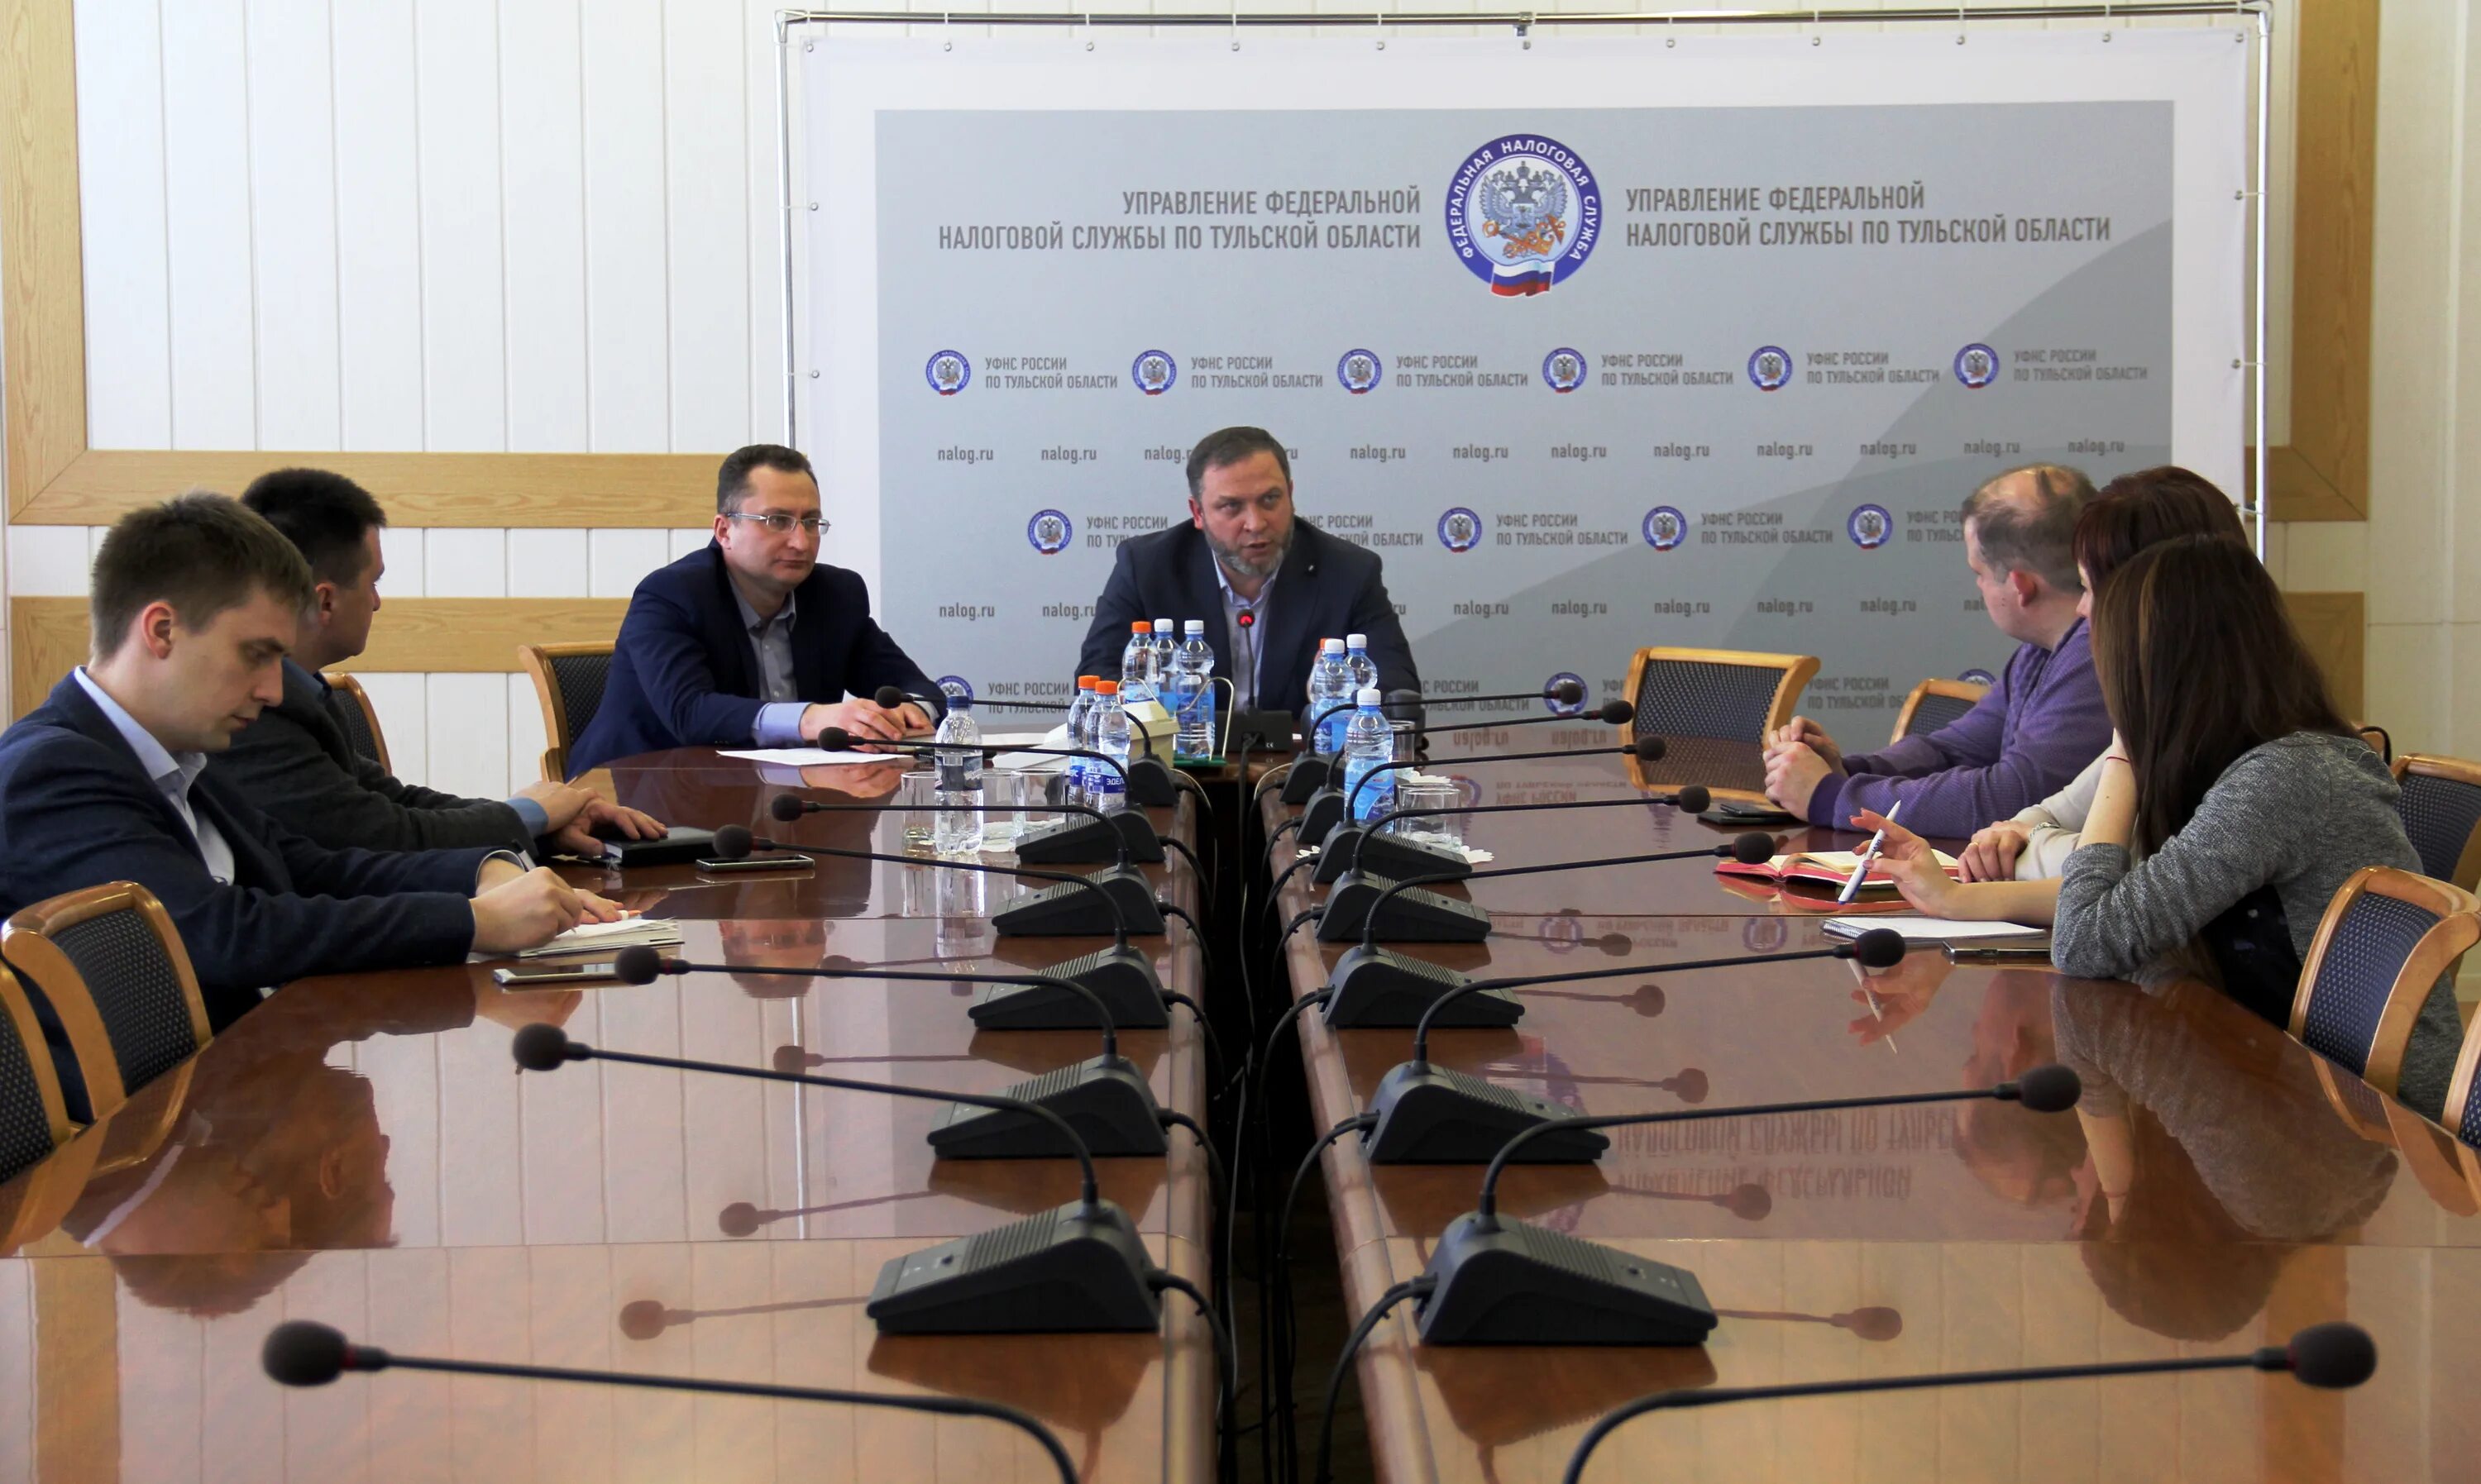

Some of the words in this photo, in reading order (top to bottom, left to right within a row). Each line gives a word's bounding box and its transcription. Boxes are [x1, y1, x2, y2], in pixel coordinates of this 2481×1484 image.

[1123, 191, 1257, 216] УПРАВЛЕНИЕ
[1266, 185, 1421, 217] ФЕДЕРАЛЬНОЙ
[1450, 150, 1494, 258] ФЕДЕРАЛЬНАЯ
[1501, 140, 1589, 186] НАЛОГОВАЯ
[1569, 195, 1597, 260] СЛУЖБА
[1627, 187, 1761, 212] УПРАВЛЕНИЕ
[1769, 180, 1924, 213] ФЕДЕРАЛЬНОЙ
[939, 220, 1064, 250] НАЛОГОВОЙ
[1073, 225, 1165, 250] СЛУЖБЫ
[1175, 225, 1202, 250] ПО
[1210, 220, 1318, 249] ТУЛЬСКОЙ
[1327, 224, 1420, 249] ОБЛАСТИ
[1627, 217, 1751, 247] НАЛОГОВОЙ
[1761, 222, 1853, 246] СЛУЖБЫ
[1863, 220, 1889, 246] ПО
[1898, 213, 2007, 245] ТУЛЬСКОЙ
[2015, 217, 2111, 243] ОБЛАСТИ
[985, 356, 1017, 371] УФНС
[1021, 356, 1067, 371] РОССИИ
[1191, 356, 1223, 370] УФНС
[1227, 356, 1273, 370] РОССИИ
[1396, 355, 1428, 369] УФНС
[1432, 355, 1478, 369] РОССИИ
[1601, 354, 1633, 367] УФНС
[1637, 354, 1683, 367] РОССИИ
[1806, 352, 1838, 365] УФНС
[1843, 352, 1889, 365] РОССИИ
[2015, 350, 2046, 363] УФНС
[2050, 350, 2096, 363] РОССИИ
[986, 373, 1001, 389] ПО
[1004, 371, 1063, 389] ТУЛЬСКОЙ
[1067, 373, 1117, 389] ОБЛАСТИ
[1192, 373, 1207, 389] ПО
[1211, 371, 1269, 389] ТУЛЬСКОЙ
[1273, 373, 1323, 389] ОБЛАСТИ
[1397, 371, 1412, 388] ПО
[1415, 370, 1474, 388] ТУЛЬСКОЙ
[1477, 371, 1528, 388] ОБЛАСТИ
[1602, 370, 1617, 386] ПО
[1621, 369, 1679, 386] ТУЛЬСКОЙ
[1683, 370, 1734, 386] ОБЛАСТИ
[1807, 369, 1823, 384] ПО
[1826, 367, 1885, 384] ТУЛЬСКОЙ
[1888, 369, 1939, 384] ОБЛАСТИ
[2014, 368, 2029, 382] ПО
[2033, 366, 2092, 382] ТУЛЬСКОЙ
[2096, 368, 2148, 382] ОБЛАСТИ
[939, 446, 993, 465] nalog.ru
[1042, 446, 1097, 465] nalog.ru
[1350, 444, 1406, 463] nalog.ru
[1453, 444, 1509, 463] nalog.ru
[1551, 443, 1607, 462] nalog.ru
[1654, 442, 1709, 460] nalog.ru
[1757, 441, 1813, 460] nalog.ru
[1862, 441, 1916, 459] nalog.ru
[1964, 440, 2020, 458] nalog.ru
[2068, 438, 2124, 456] nalog.ru
[1087, 516, 1118, 529] УФНС
[1122, 516, 1168, 529] РОССИИ
[1327, 515, 1374, 527] РОССИИ
[1496, 514, 1528, 527] УФНС
[1532, 514, 1578, 527] РОССИИ
[1701, 513, 1733, 525] УФНС
[1738, 513, 1783, 525] РОССИИ
[1087, 535, 1102, 547] ПО
[1373, 533, 1423, 546] ОБЛАСТИ
[1497, 531, 1512, 546] ПО
[1516, 529, 1573, 546] ТУЛЬСКОЙ
[1577, 531, 1628, 546] ОБЛАСТИ
[1702, 529, 1717, 544] ПО
[1721, 527, 1778, 544] ТУЛЬСКОЙ
[1782, 529, 1833, 544] ОБЛАСТИ
[1907, 529, 1922, 542] ПО
[940, 602, 995, 621] nalog.ru
[1043, 602, 1097, 621] nalog.ru
[1454, 600, 1508, 618] nalog.ru
[1552, 600, 1607, 618] nalog.ru
[1656, 599, 1710, 618] nalog.ru
[1758, 599, 1814, 617] nalog.ru
[1861, 597, 1916, 615] nalog.ru
[988, 682, 1020, 695] УФНС
[1024, 682, 1069, 695] РОССИИ
[1434, 680, 1480, 693] РОССИИ
[1843, 678, 1889, 691] РОССИИ
